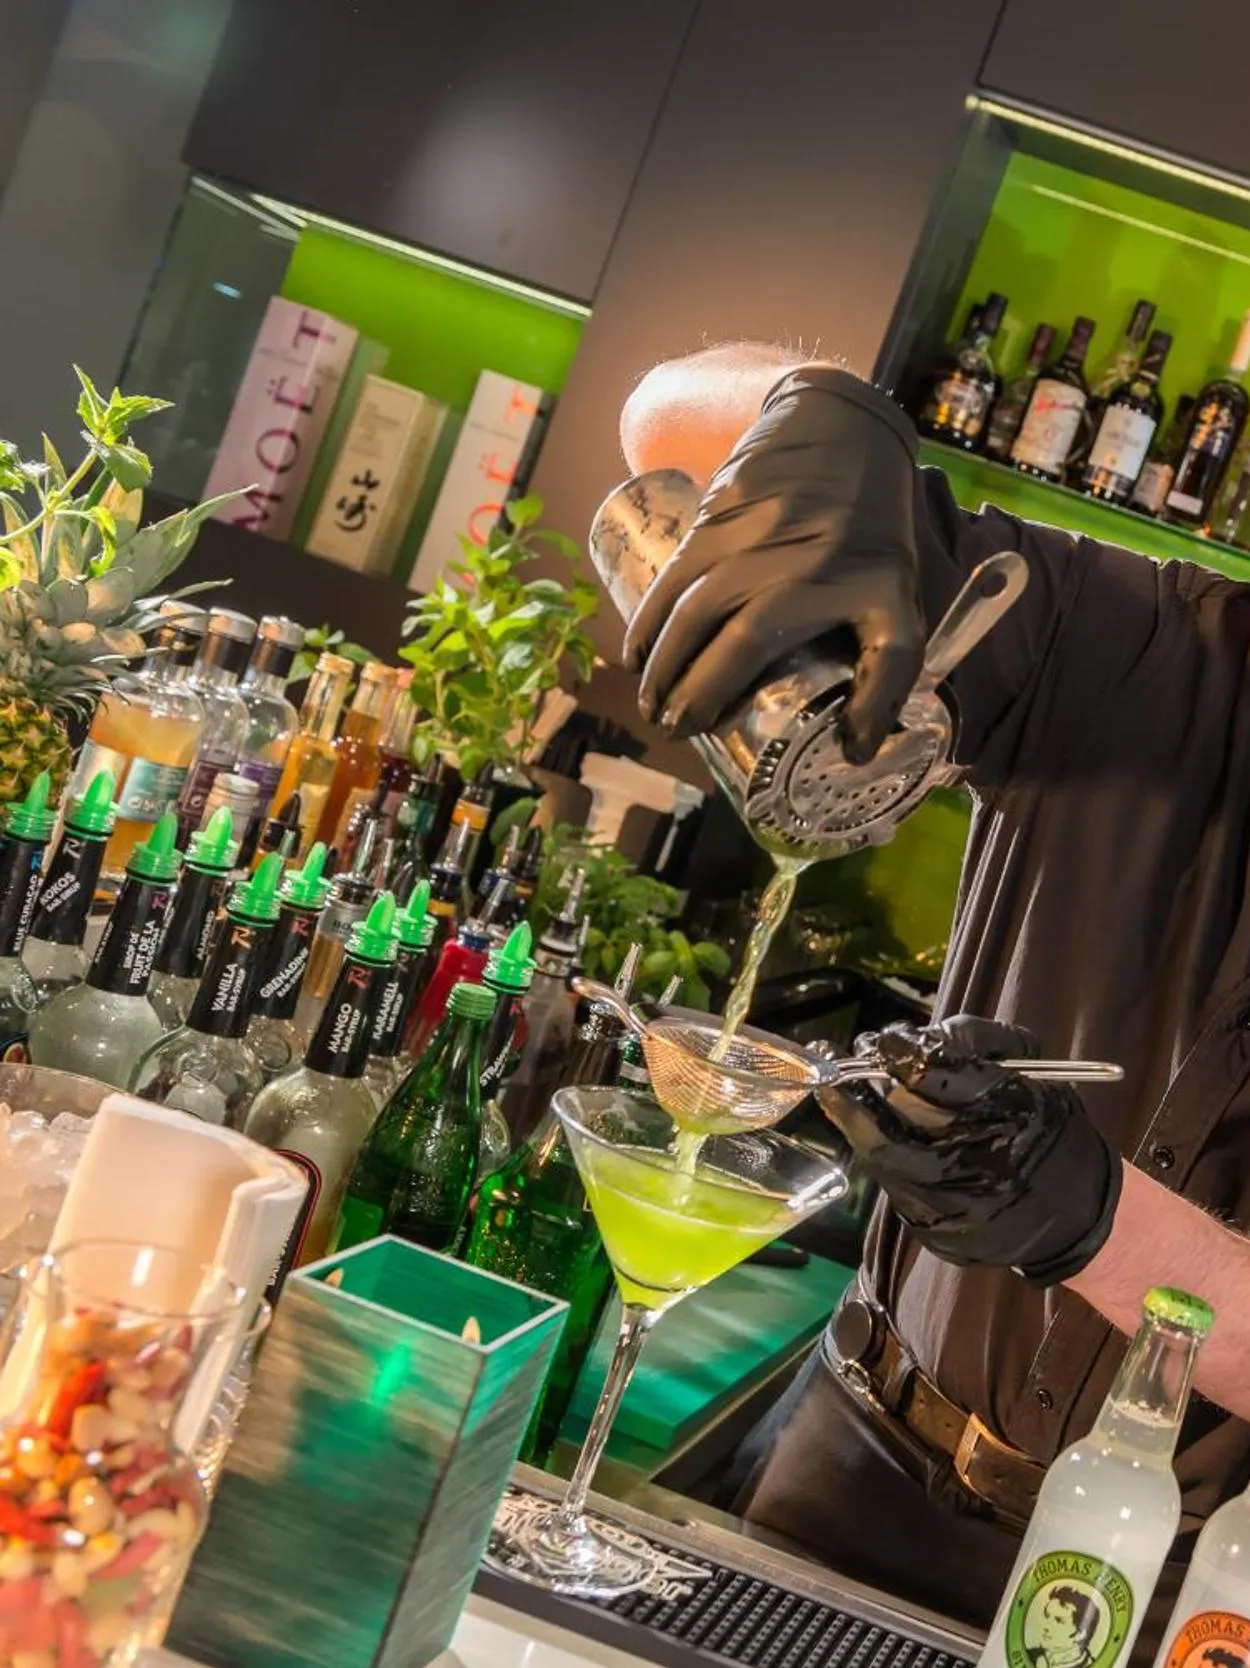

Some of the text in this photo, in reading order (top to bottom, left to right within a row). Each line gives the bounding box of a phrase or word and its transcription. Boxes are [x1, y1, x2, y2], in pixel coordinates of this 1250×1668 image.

[40, 872, 77, 906] KOKOS
[129, 920, 156, 984] FRUIT DE LA
[212, 963, 238, 1011] VANILLA
[372, 981, 399, 1040] KARAMELL
[327, 1003, 352, 1054] MANGO
[1033, 1558, 1093, 1582] THOMAS
[1186, 1619, 1246, 1643] THOMAS
